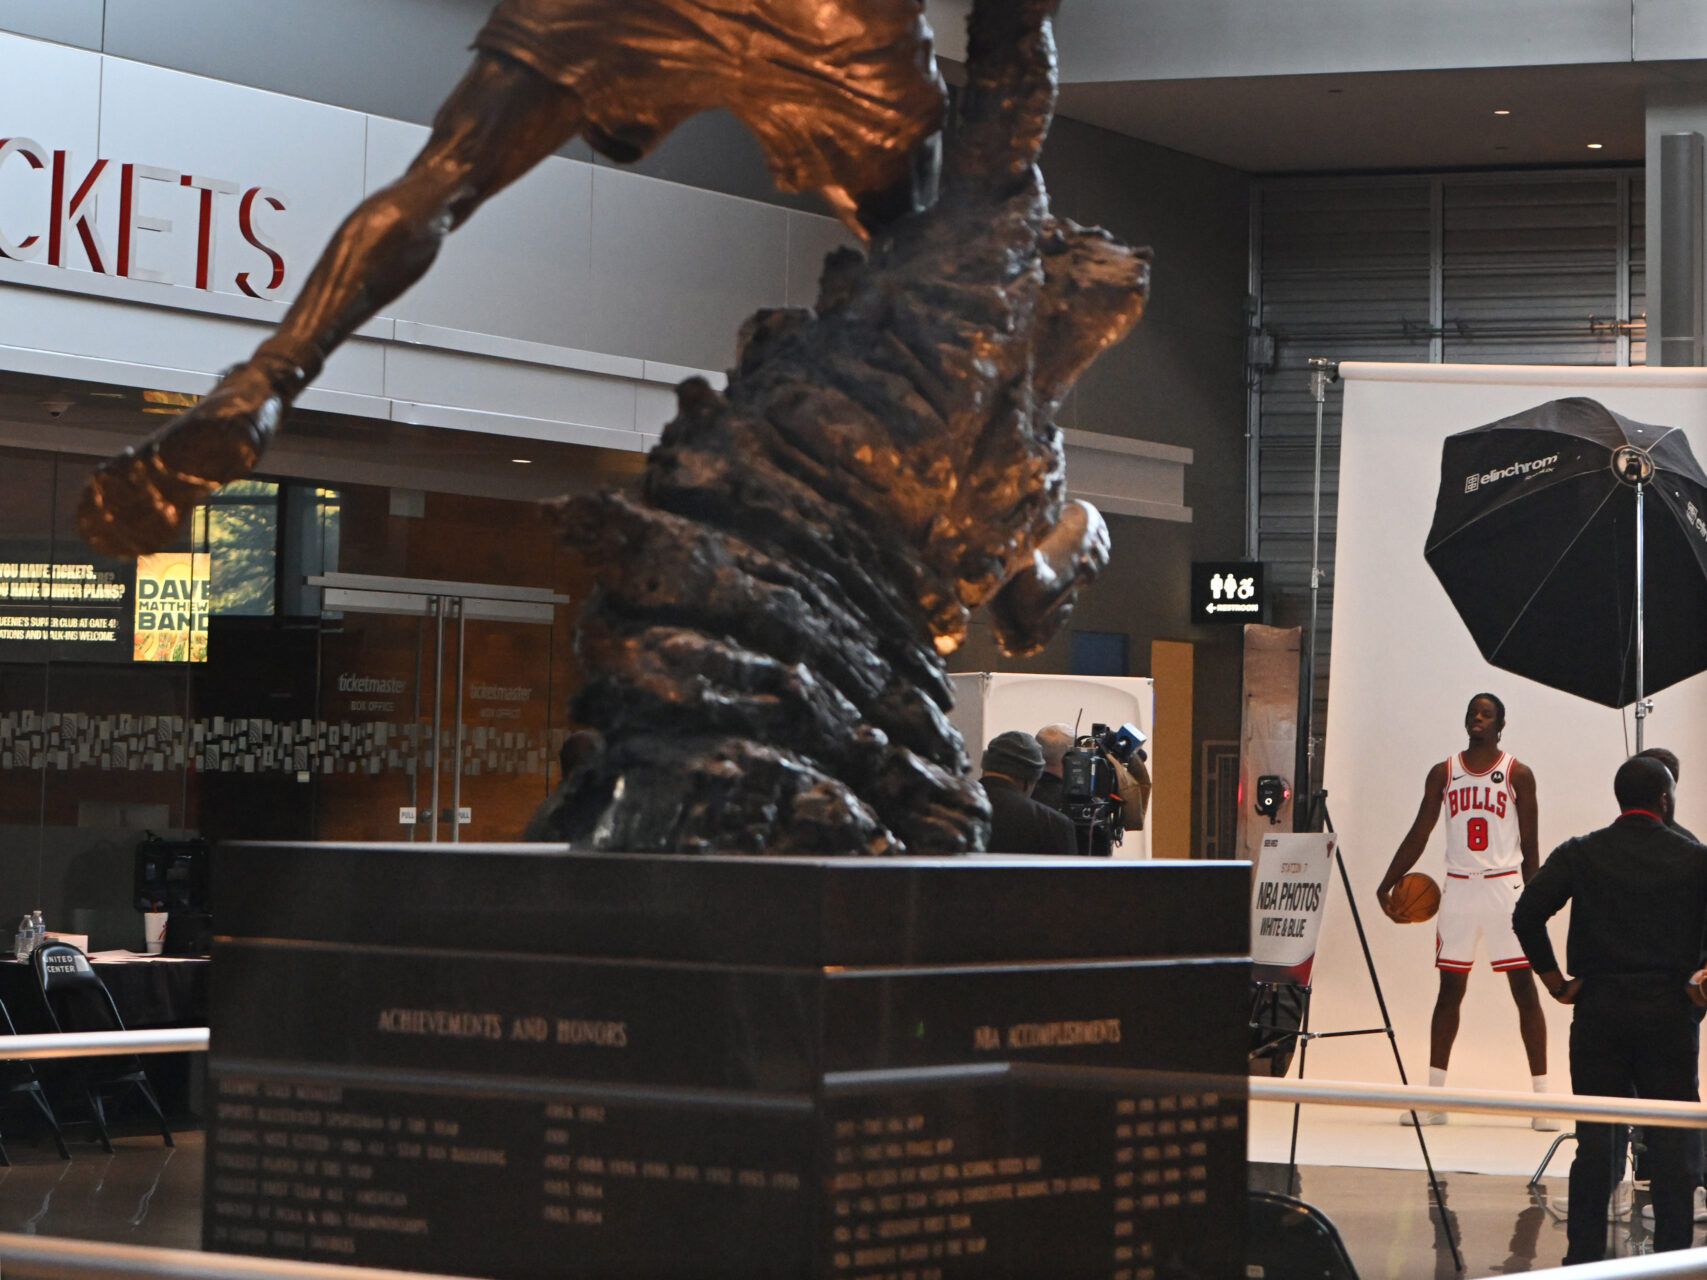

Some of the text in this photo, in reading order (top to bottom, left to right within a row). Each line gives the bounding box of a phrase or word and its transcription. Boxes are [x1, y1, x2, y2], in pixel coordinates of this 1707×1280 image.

[1480, 454, 1558, 485] elinchrom
[20, 563, 50, 578] HAVE
[52, 564, 97, 580] TICKETS.
[10, 582, 40, 597] HAVE
[41, 582, 82, 598] DINNER
[83, 583, 125, 599] PLANS?
[138, 579, 210, 601] DAVE
[59, 618, 78, 628] CLUB
[79, 618, 89, 628] AT
[89, 618, 108, 629] GATE
[25, 629, 42, 640] AND
[79, 631, 117, 642] WELCOME.
[338, 673, 407, 694] ticketmaster
[470, 683, 532, 702] ticketmaster
[351, 700, 396, 712] BOX OFFICE
[1448, 786, 1508, 819] BULLS
[1467, 817, 1488, 852] 8
[1256, 881, 1322, 912] NBA PHOTOS
[1260, 917, 1307, 938] WHITE & BLUE
[47, 965, 75, 973] CENTER
